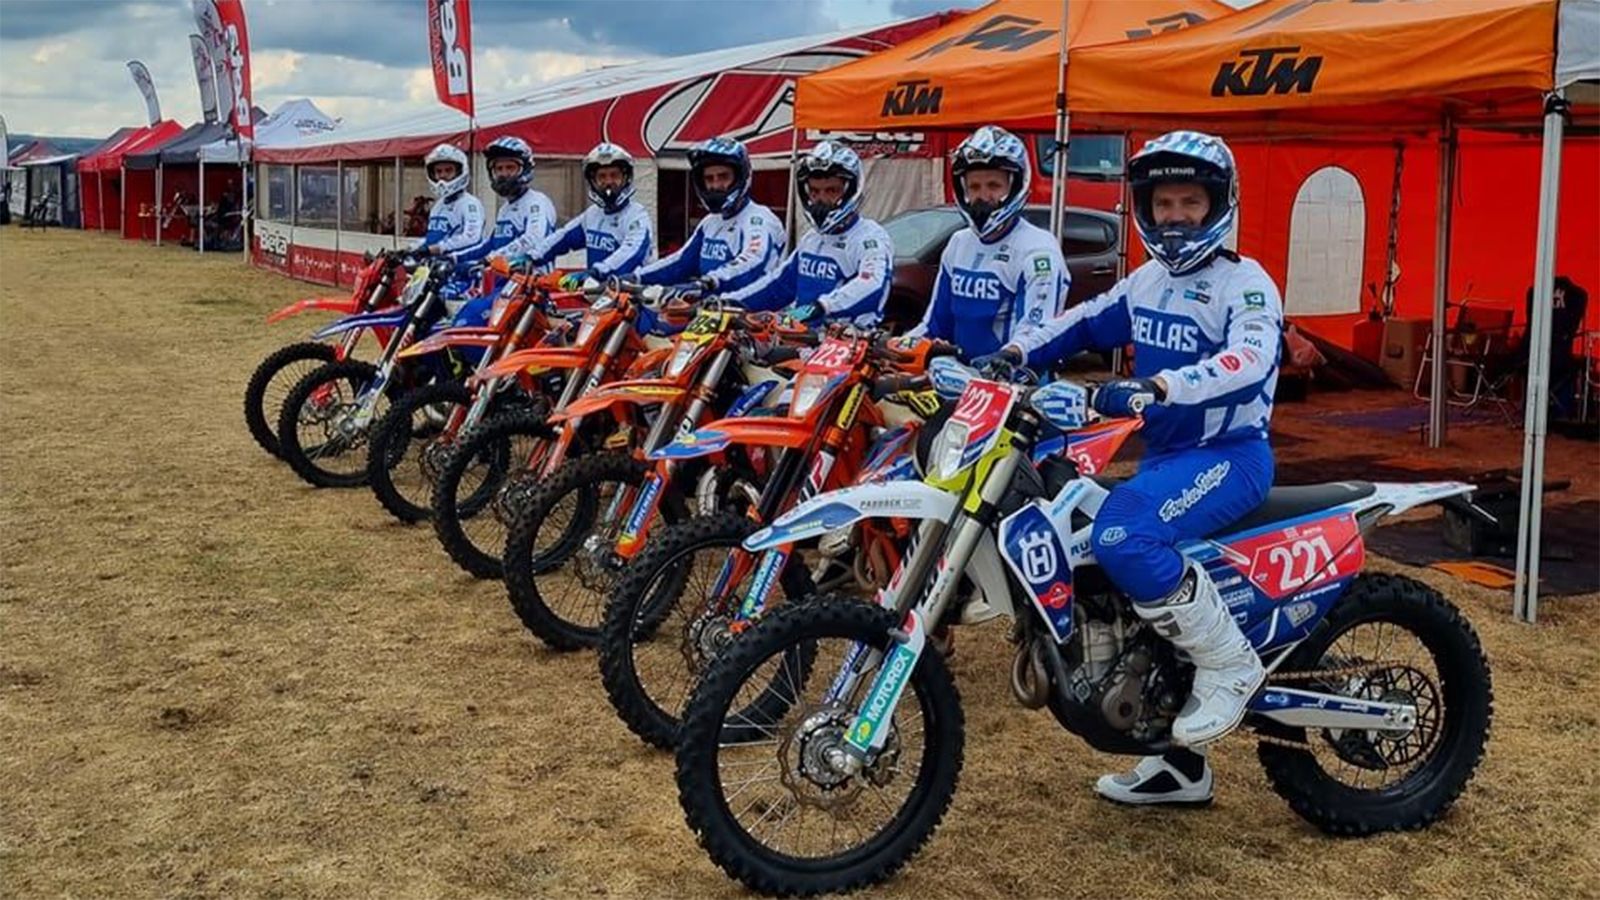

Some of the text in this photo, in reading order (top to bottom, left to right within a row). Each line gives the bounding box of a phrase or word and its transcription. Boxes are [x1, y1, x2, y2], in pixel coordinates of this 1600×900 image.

[1210, 45, 1324, 97] KTM
[880, 78, 944, 118] KTM
[586, 231, 616, 252] ELLAS
[700, 241, 728, 261] ELLAS
[951, 273, 1000, 301] ELLAS
[953, 386, 995, 422] 221
[1269, 534, 1339, 592] 221
[866, 651, 911, 723] MOTOREX
